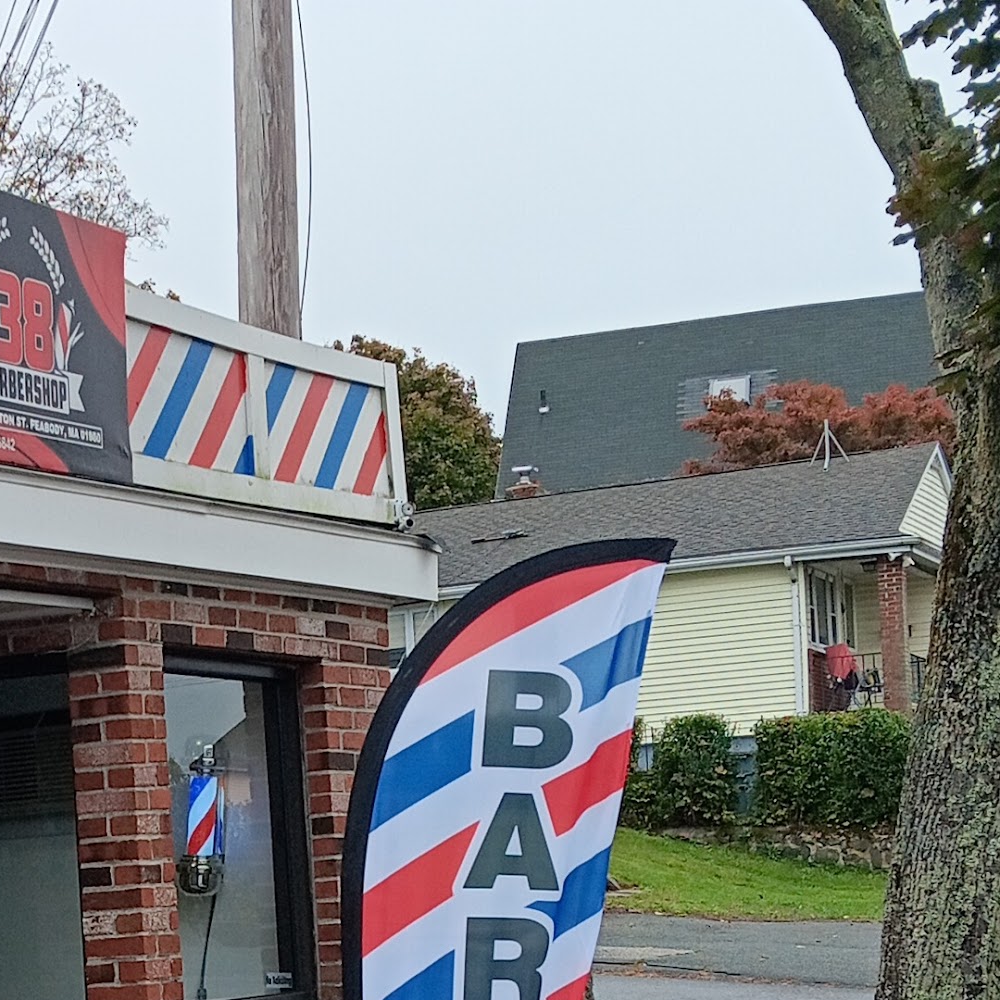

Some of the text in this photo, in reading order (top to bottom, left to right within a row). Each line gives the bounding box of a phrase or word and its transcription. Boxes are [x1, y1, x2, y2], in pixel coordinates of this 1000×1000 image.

[15, 415, 29, 429] ST.
[29, 418, 67, 439] PEABODY,
[67, 426, 80, 440] MA
